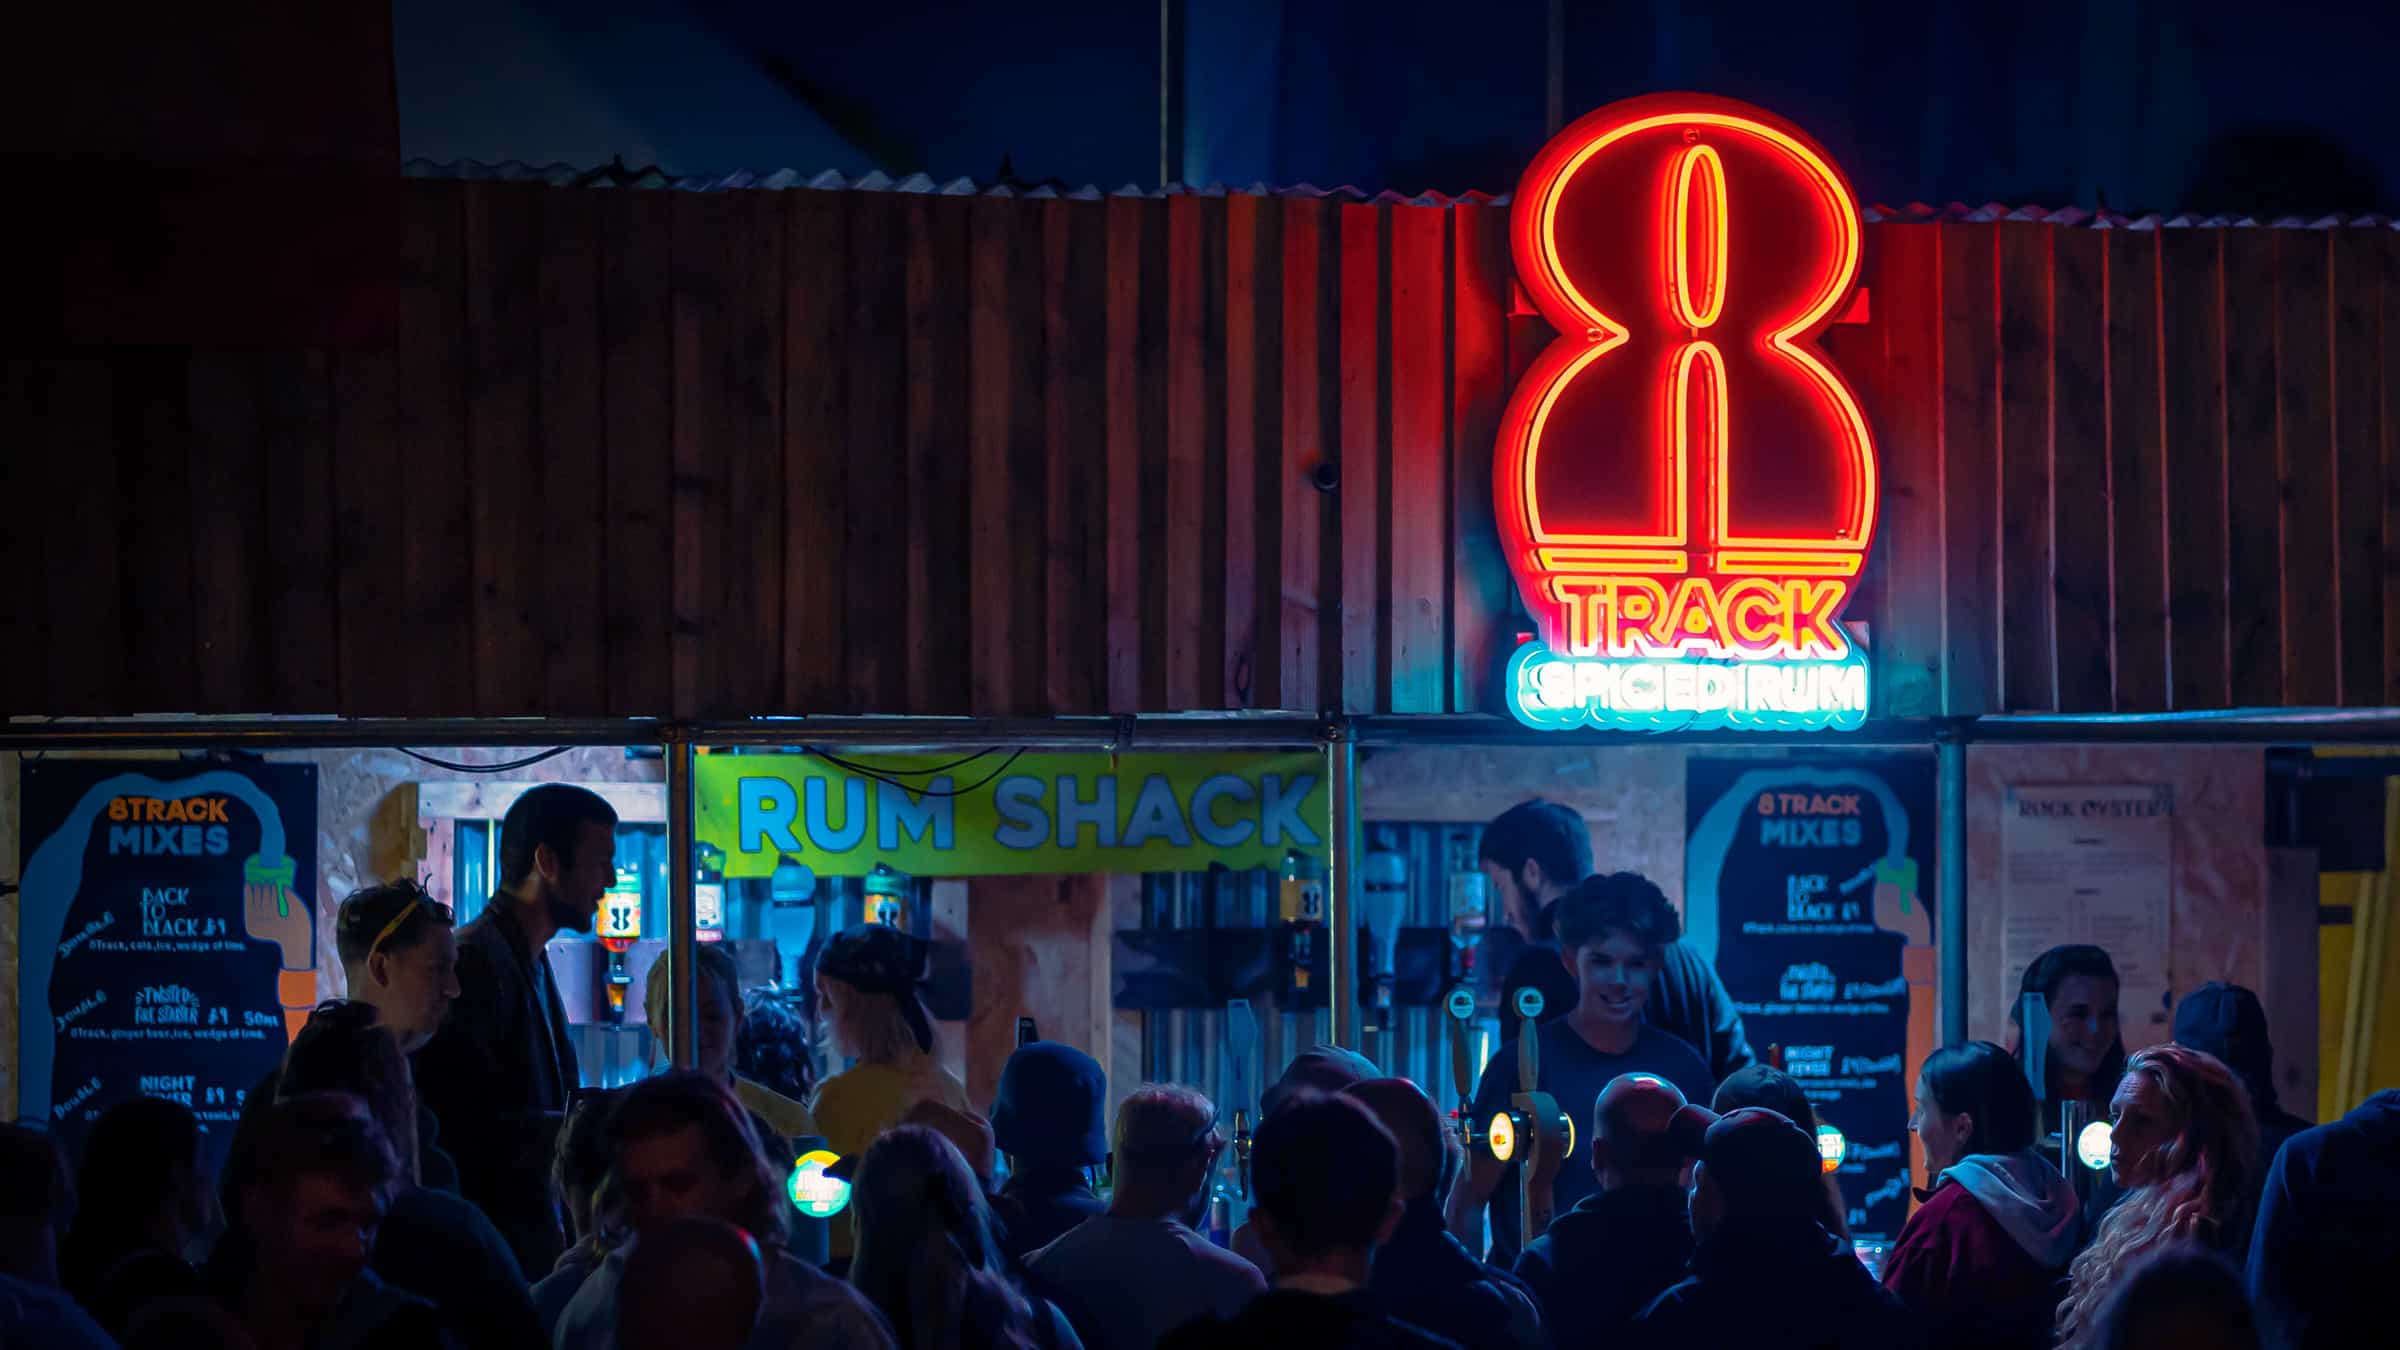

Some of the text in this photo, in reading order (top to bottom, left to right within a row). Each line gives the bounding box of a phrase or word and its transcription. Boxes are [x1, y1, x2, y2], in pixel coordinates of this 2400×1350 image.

[1524, 112, 1876, 576] 8
[1552, 577, 1847, 660] TRACK
[1519, 661, 1866, 713] SPICED RUM
[108, 797, 230, 822] 8TRACK
[738, 774, 1322, 853] RUM SHACK
[2019, 799, 2172, 818] ROCK OYSTER
[110, 826, 230, 856] MIXES
[1760, 819, 1862, 848] MIXES
[143, 918, 198, 937] BLACK
[140, 1075, 196, 1092] NIGHT
